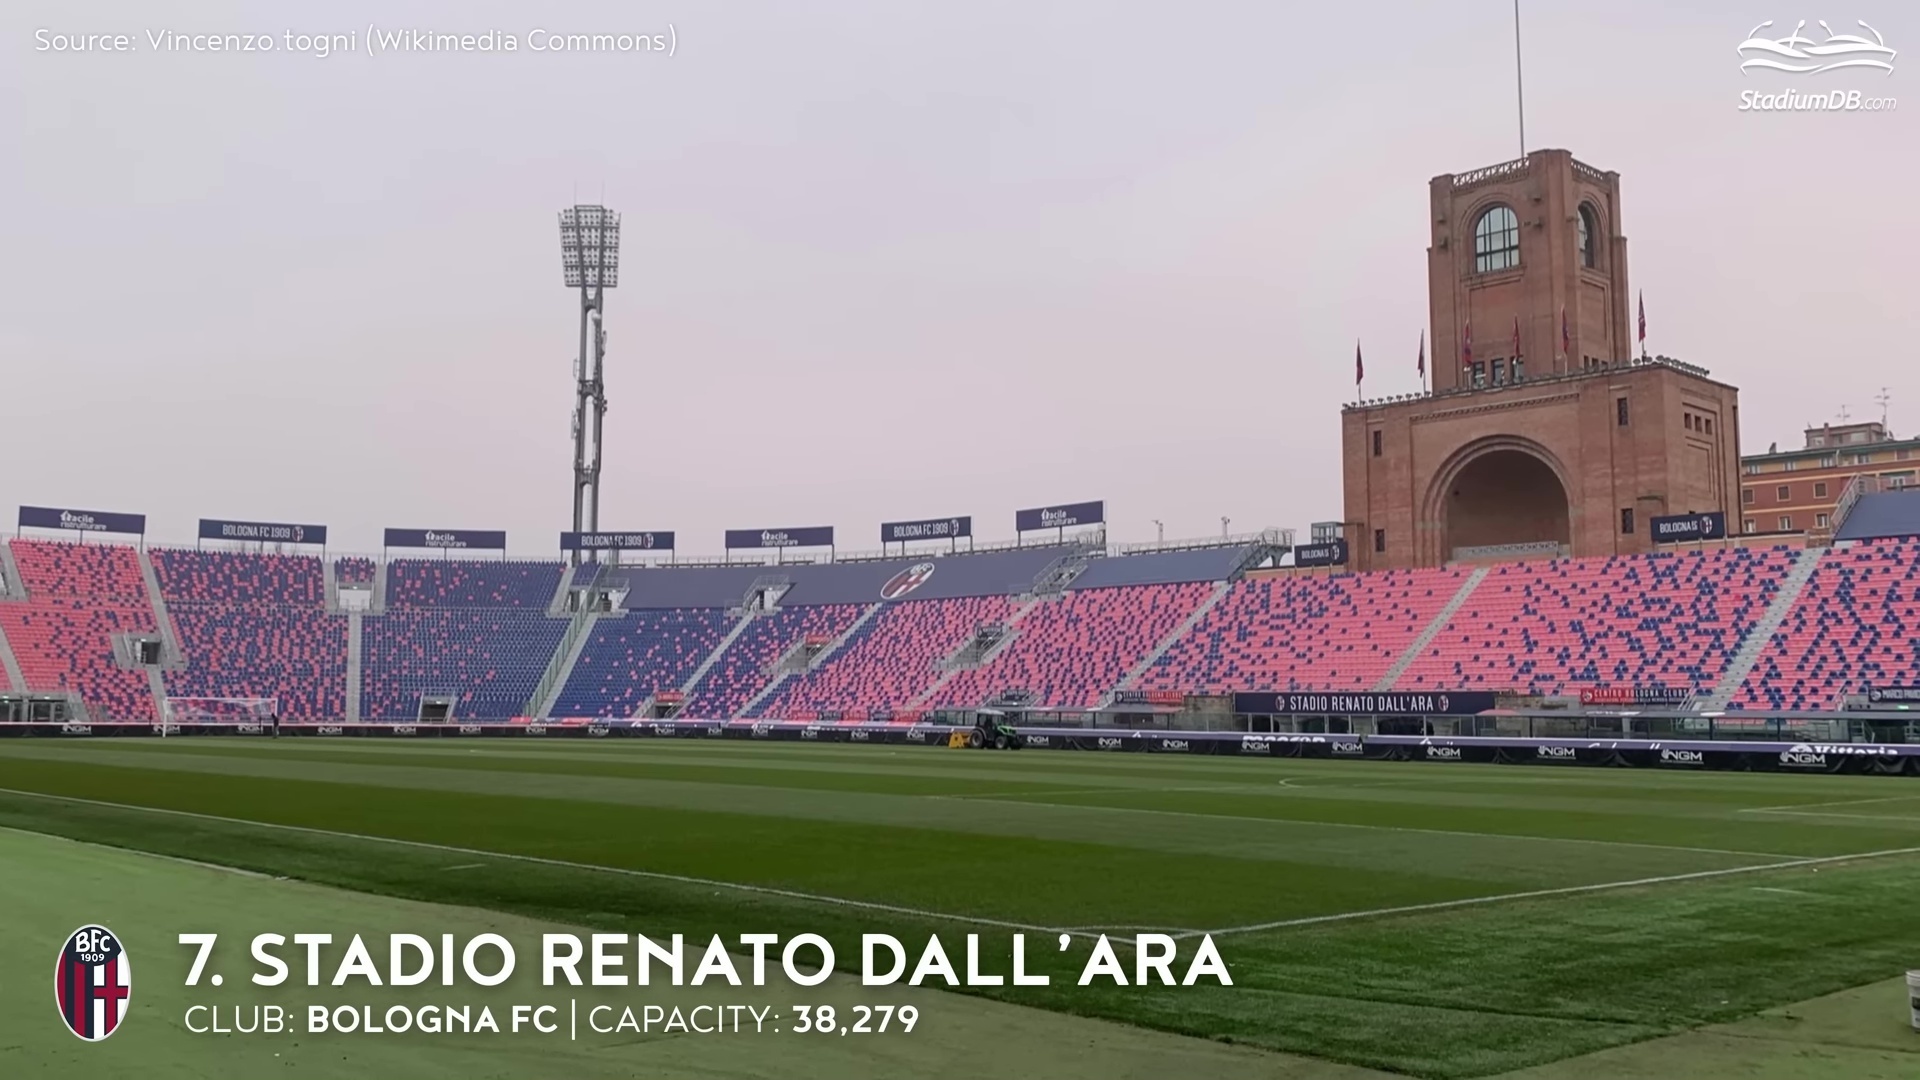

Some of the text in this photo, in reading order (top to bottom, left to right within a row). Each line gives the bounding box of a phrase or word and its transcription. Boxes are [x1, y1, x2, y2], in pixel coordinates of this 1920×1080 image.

[222, 524, 291, 538] BOLOGNA FC 1909
[893, 522, 949, 537] BOLOGNA FC 1909
[1660, 521, 1692, 533] BOLOGNA
[581, 535, 642, 546] BOLOGNA FC 1909
[1625, 688, 1659, 698] BOLOGNA
[1290, 695, 1434, 712] STADIO RENATO DALL'ARA
[1165, 740, 1188, 748] NGM
[1245, 742, 1269, 750] NGM
[1337, 743, 1363, 751] NGM
[1431, 747, 1460, 756] NGM
[1543, 747, 1575, 757] NGM
[1667, 751, 1702, 761] NGM
[1787, 753, 1826, 764] NGM
